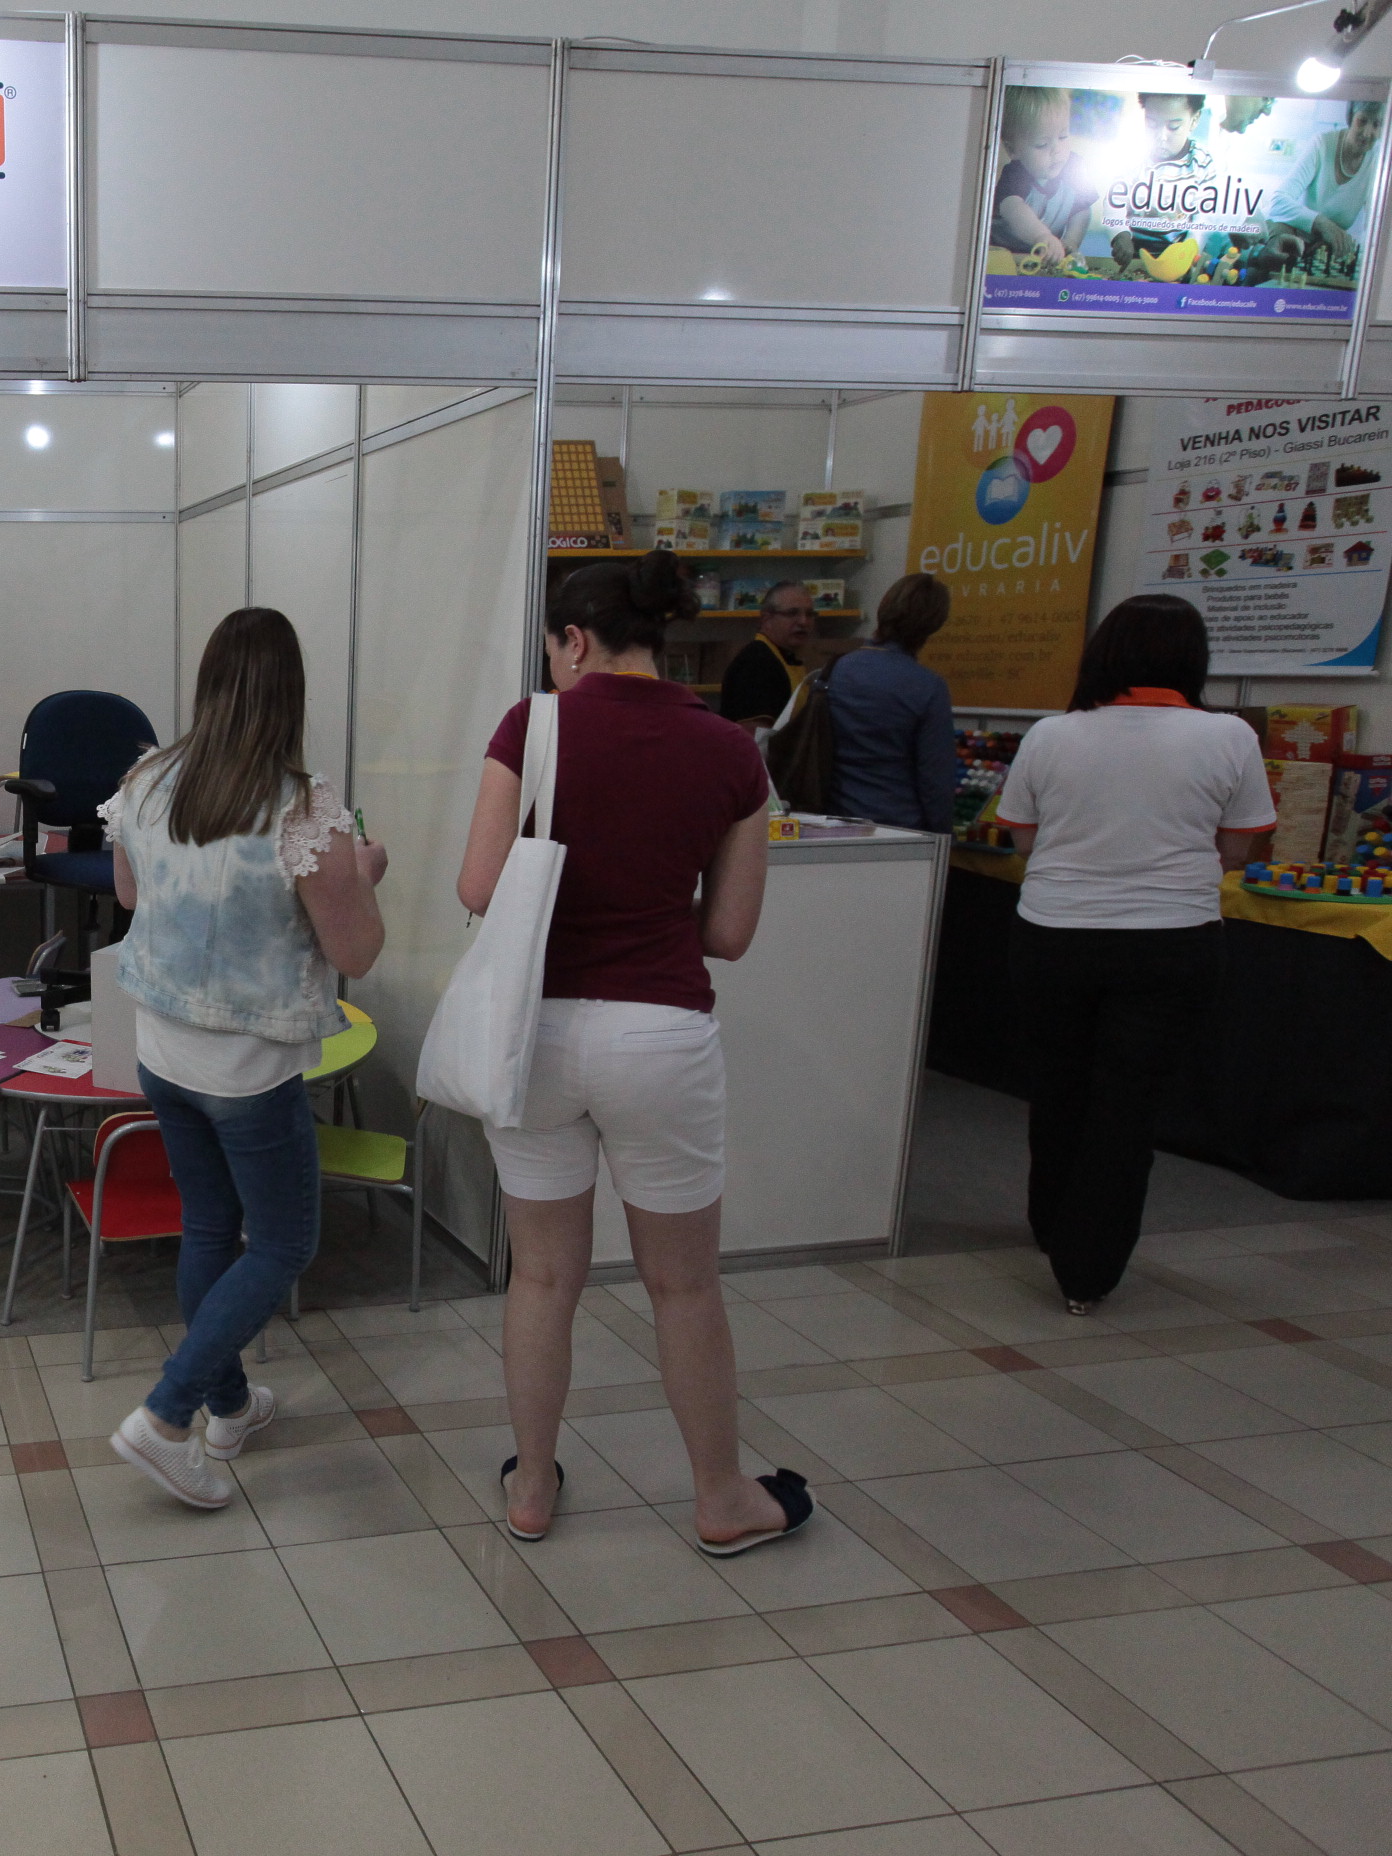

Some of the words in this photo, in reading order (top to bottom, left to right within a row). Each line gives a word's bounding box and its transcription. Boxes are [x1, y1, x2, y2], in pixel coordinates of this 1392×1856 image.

[1107, 170, 1264, 216] educaliv
[1102, 216, 1124, 227] Jogos
[1125, 219, 1131, 227] e
[1130, 219, 1175, 229] brinquedos
[1176, 221, 1217, 232] educativos
[1218, 223, 1228, 232] de
[1229, 225, 1261, 234] madeira
[1071, 292, 1085, 302] (47)
[1179, 428, 1244, 453] VENHA
[1247, 419, 1291, 442] NOS
[1297, 404, 1381, 434] VISITAR
[1167, 459, 1192, 472] Loja
[1193, 452, 1216, 468] 216
[1239, 445, 1271, 462] Piso)
[1283, 436, 1324, 455] Giassi
[1327, 427, 1390, 448] Bucarein
[547, 536, 589, 549] OGICO
[919, 521, 1089, 575] educaliv
[950, 579, 1061, 597] IVRARIA
[1202, 584, 1247, 594] Brinquedos
[1248, 583, 1262, 591] em
[1263, 581, 1298, 591] madeira
[1206, 594, 1242, 603] Produtos
[1244, 594, 1262, 603] para
[1264, 592, 1290, 601] bebês
[1207, 604, 1239, 613] Material
[1240, 604, 1251, 612] de
[1253, 602, 1287, 611] inclusão
[1221, 614, 1231, 622] de
[1233, 614, 1256, 624] apoio
[1269, 613, 1309, 621] educador
[1216, 624, 1256, 632] atividades
[1258, 623, 1334, 633] psicopedagógicas
[1222, 634, 1262, 642] atividades
